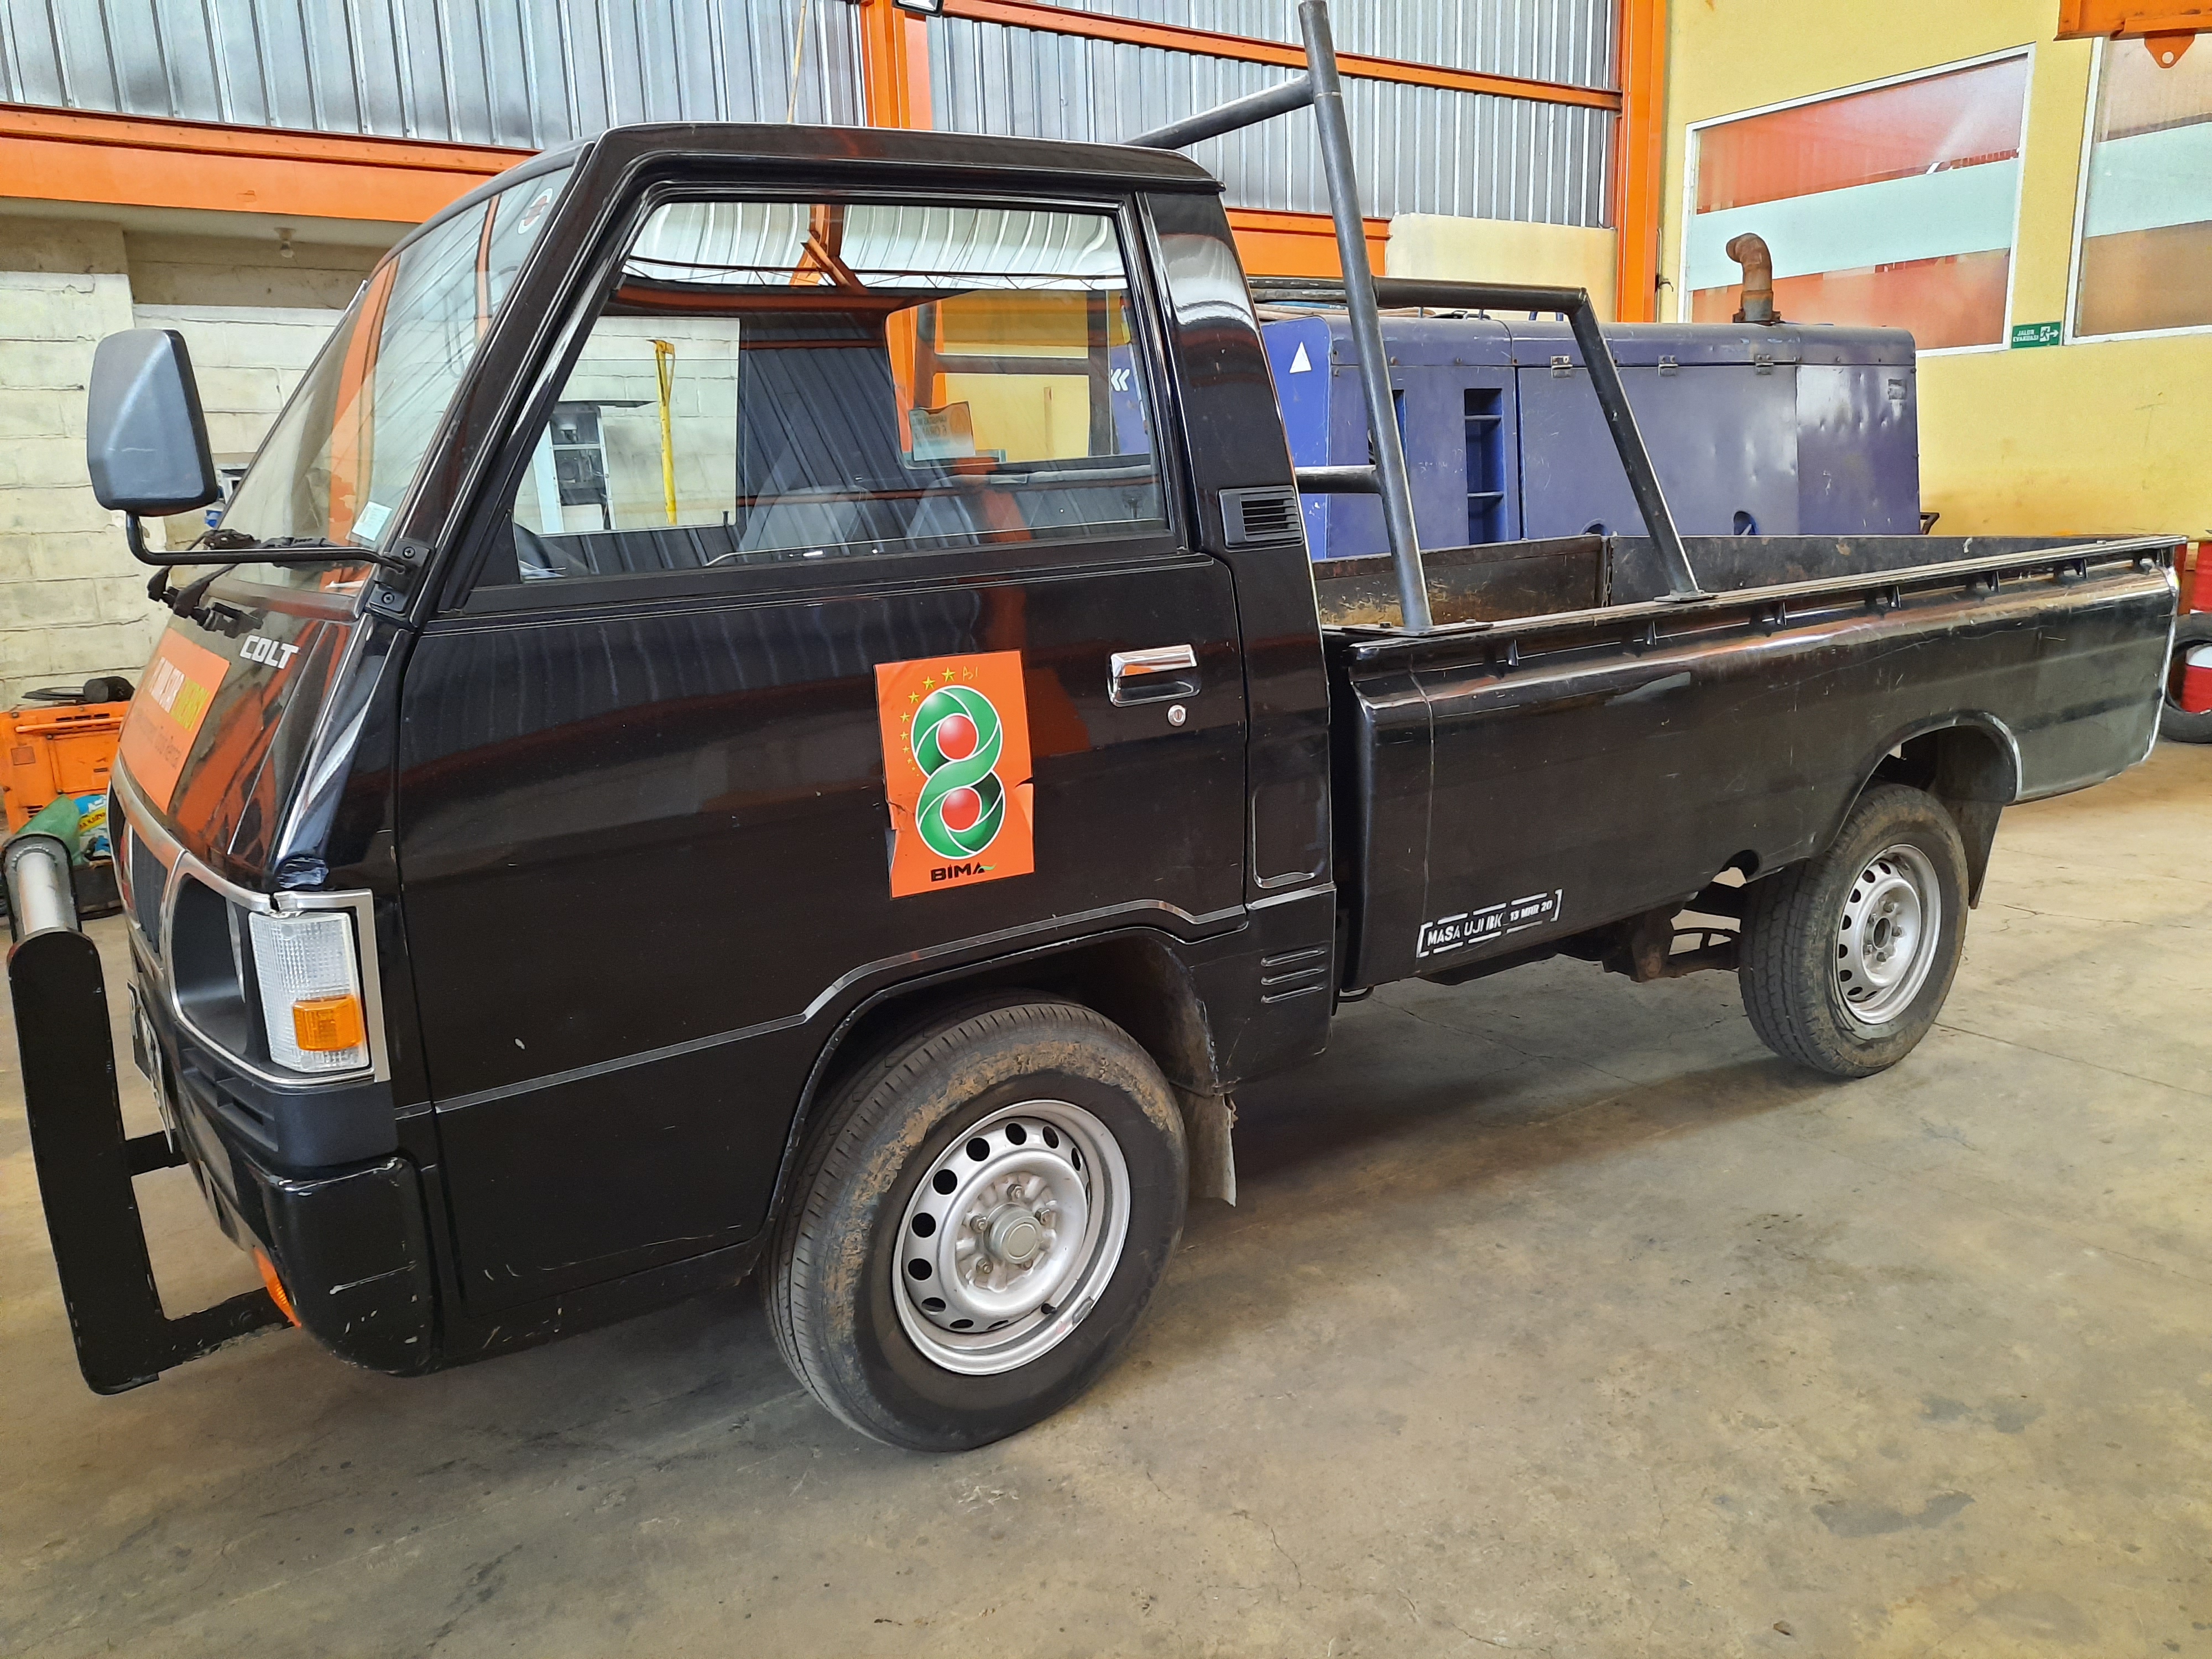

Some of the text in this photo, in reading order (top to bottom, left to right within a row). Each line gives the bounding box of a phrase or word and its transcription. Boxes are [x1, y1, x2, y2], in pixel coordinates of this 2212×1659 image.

[239, 635, 299, 669] COLT
[930, 862, 987, 882] BIMA
[1427, 925, 1460, 947] MASA
[1464, 918, 1485, 936] UJI
[1510, 910, 1520, 922] 13
[1541, 900, 1553, 912] 20
